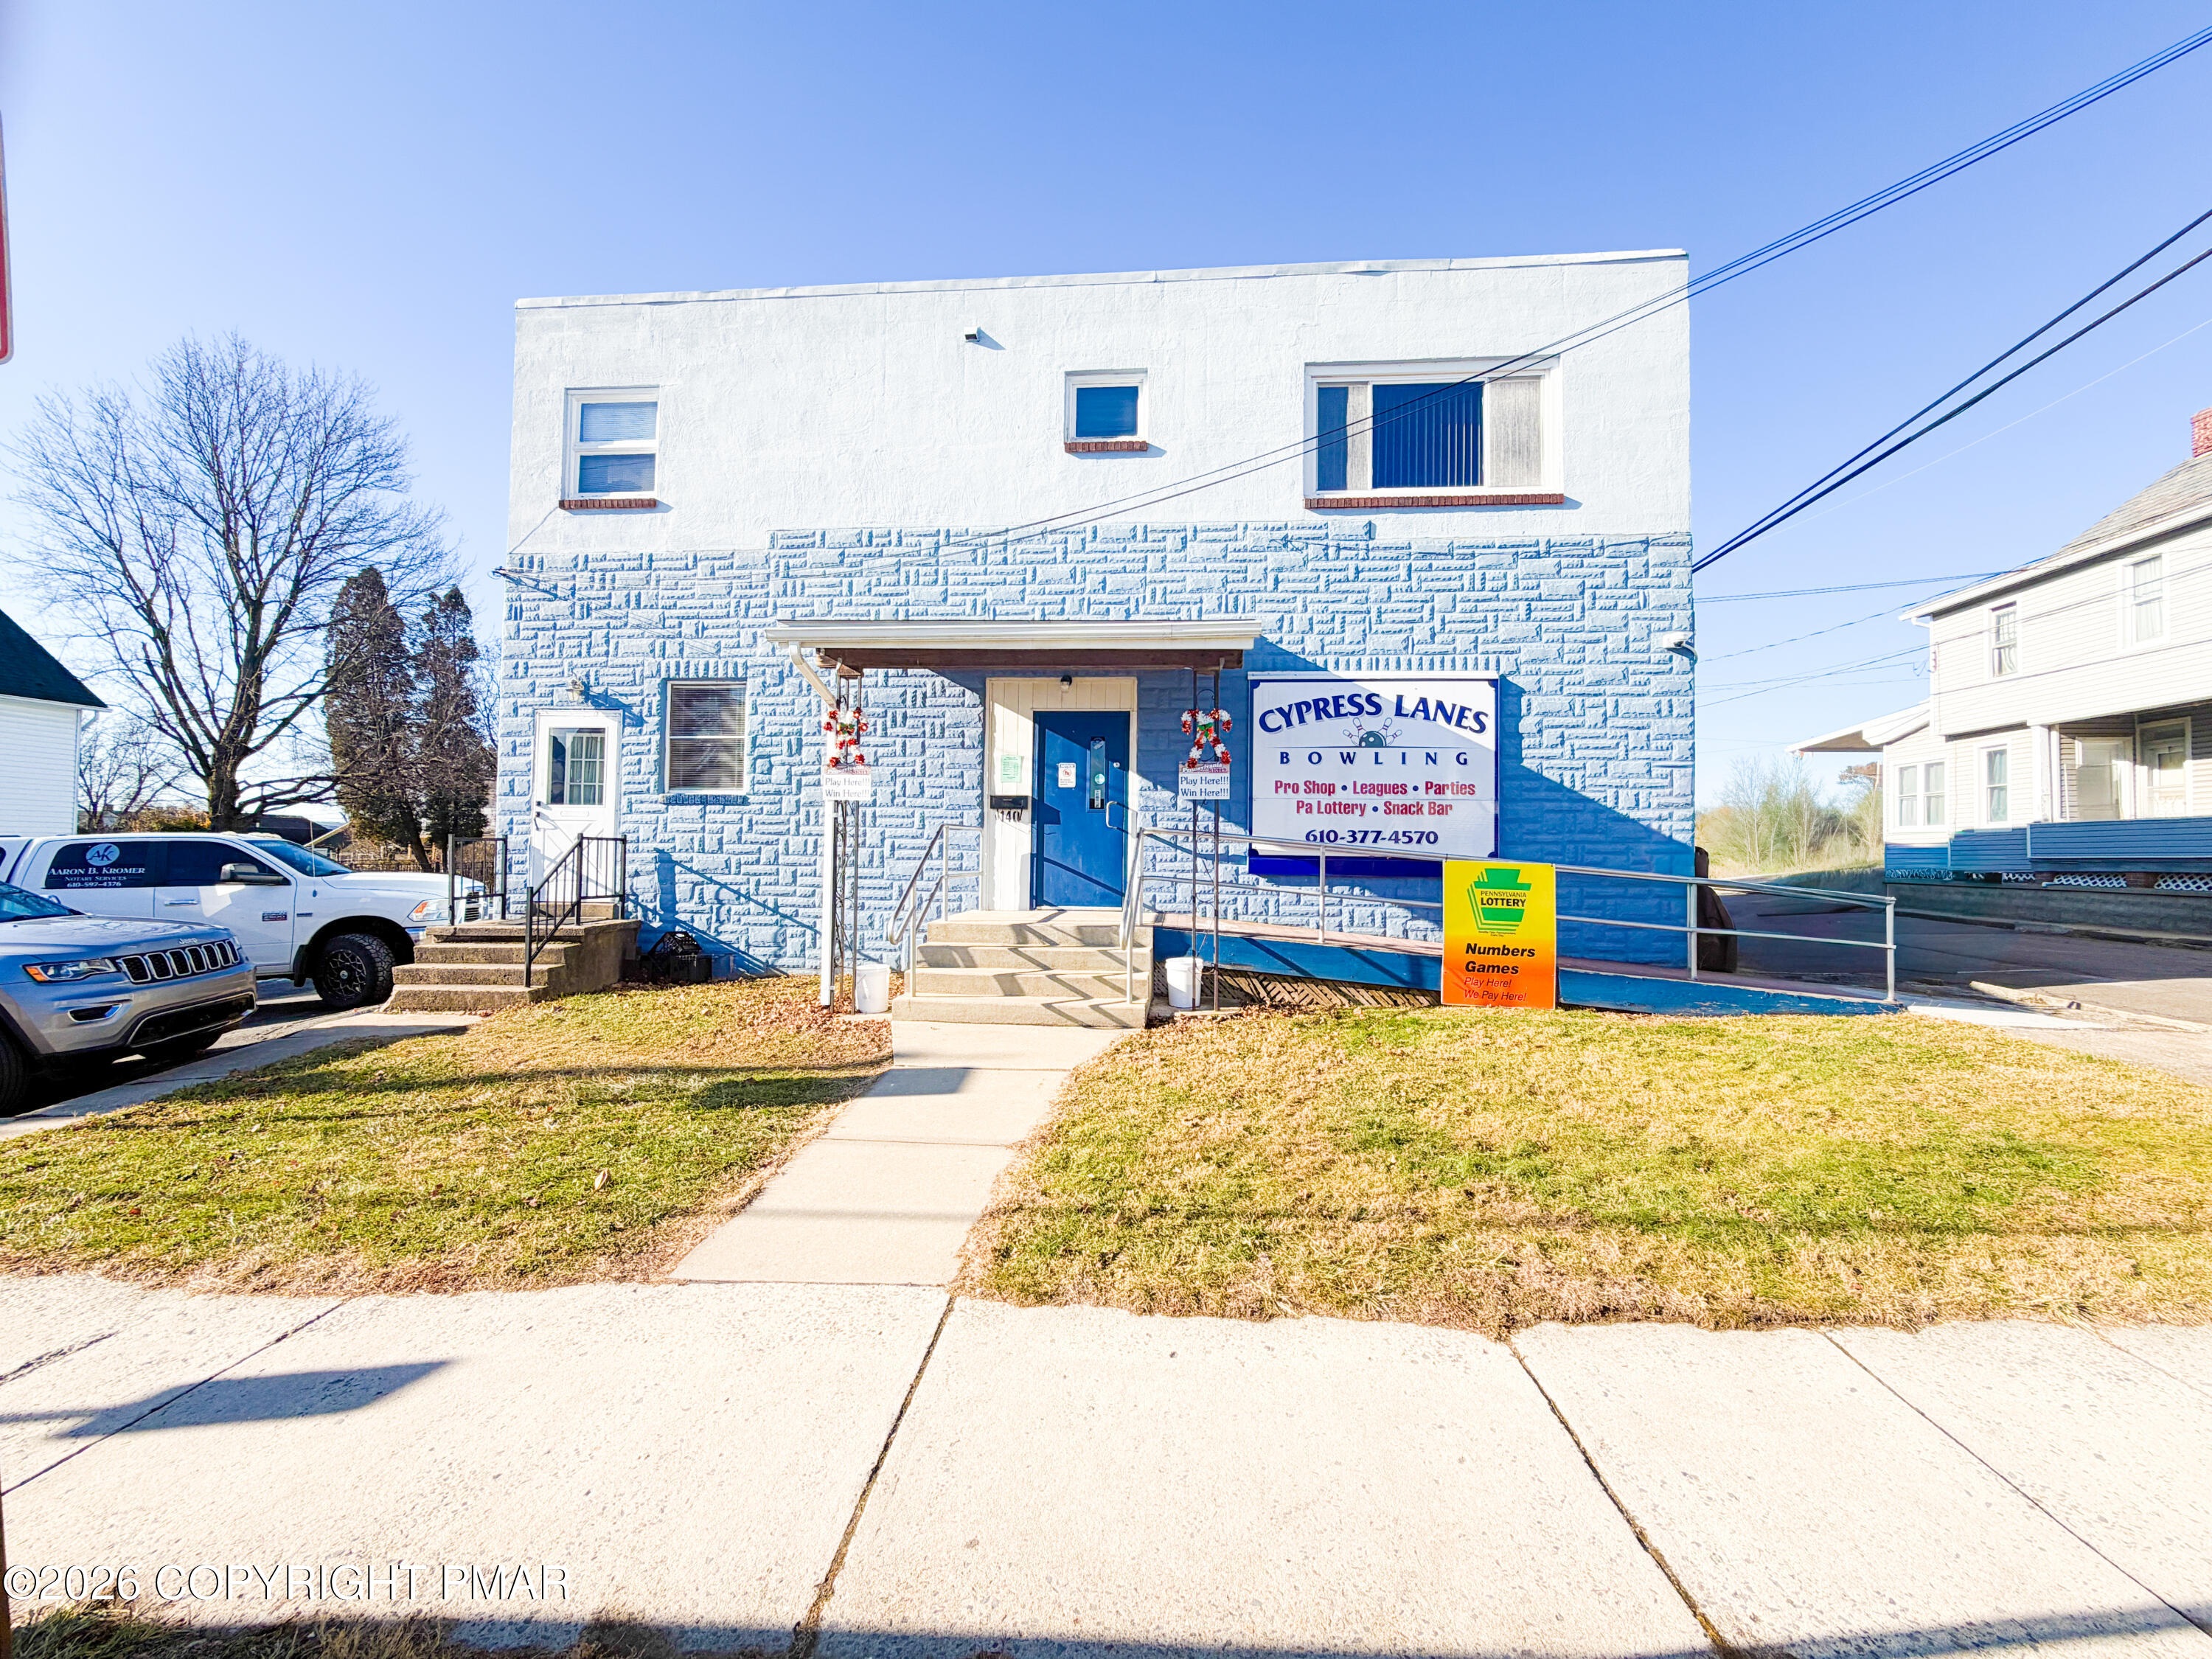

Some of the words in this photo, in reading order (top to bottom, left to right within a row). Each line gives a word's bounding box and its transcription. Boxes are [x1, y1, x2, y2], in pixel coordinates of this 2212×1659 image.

[1259, 692, 1382, 733] CYPRESS
[1395, 695, 1489, 734] LANES
[1280, 751, 1468, 765] BOWLING
[825, 778, 841, 787] Play
[844, 778, 870, 786] Here!!!
[1180, 776, 1197, 786] Play
[1200, 776, 1228, 785] Here!!!
[825, 789, 841, 797] Win
[843, 789, 869, 797] Here!!!
[1180, 788, 1197, 796] Win
[1200, 788, 1228, 796] Here!!!
[1274, 780, 1299, 794] Pro
[1304, 780, 1336, 796] Shop
[1353, 781, 1408, 796] Leagues
[1425, 782, 1475, 796] Parties
[1296, 800, 1313, 814] Pa
[1317, 801, 1366, 817] Lottery
[1384, 801, 1424, 815] Snack
[1428, 801, 1453, 815] Bar
[1000, 810, 1020, 822] 140
[1305, 830, 1439, 844] 610-377-4570
[1481, 897, 1526, 907] LOTTERY
[1465, 943, 1536, 957] Numbers
[1465, 961, 1519, 975] Games
[1464, 977, 1484, 988] Play
[1486, 978, 1512, 988] Here!
[1464, 990, 1479, 999] We
[1482, 990, 1499, 1001] Pay
[1501, 992, 1527, 1001] Here!
